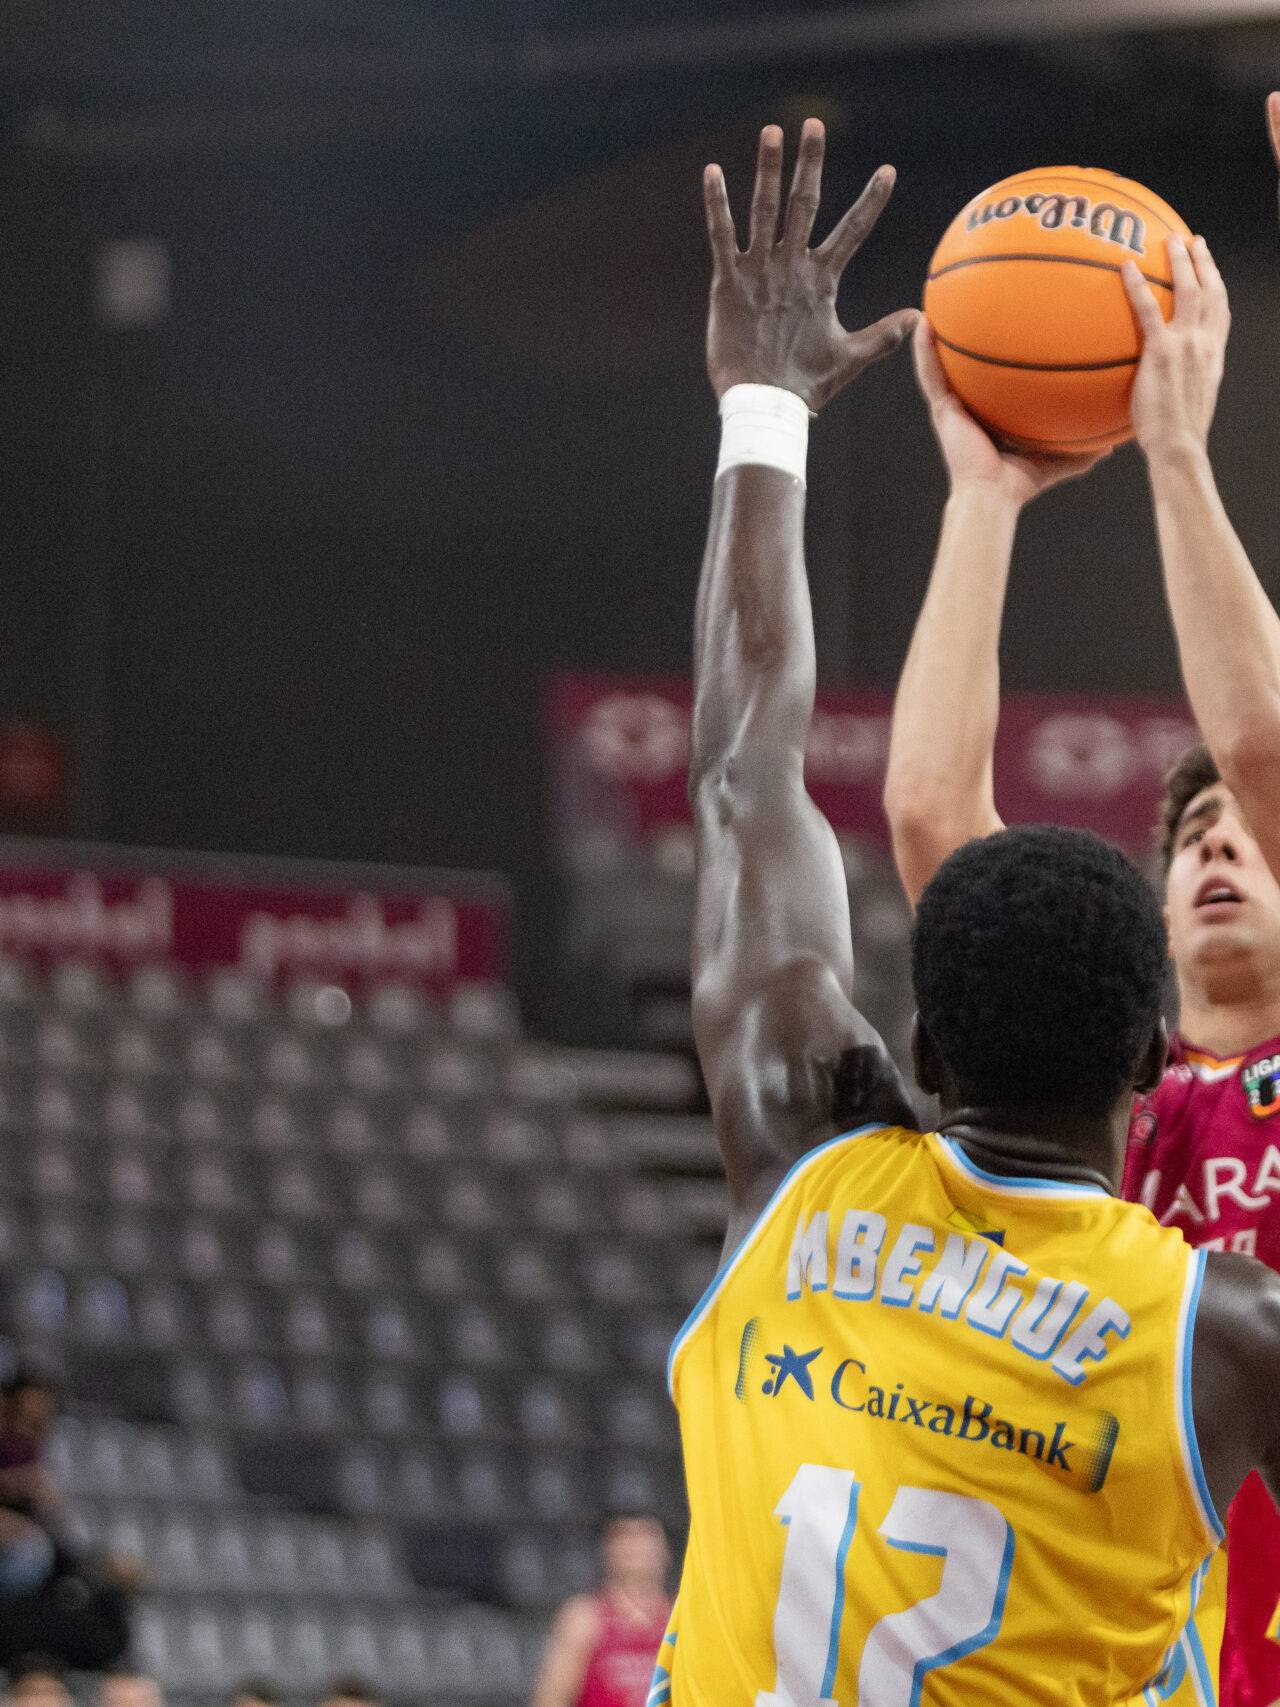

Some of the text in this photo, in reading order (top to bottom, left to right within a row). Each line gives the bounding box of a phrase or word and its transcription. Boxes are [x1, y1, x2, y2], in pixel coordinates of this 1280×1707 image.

[965, 192, 1147, 255] Wilson
[786, 1208, 1131, 1386] MBENGUE
[830, 1358, 1077, 1473] CaixaBank
[773, 1463, 1016, 1707] 12
